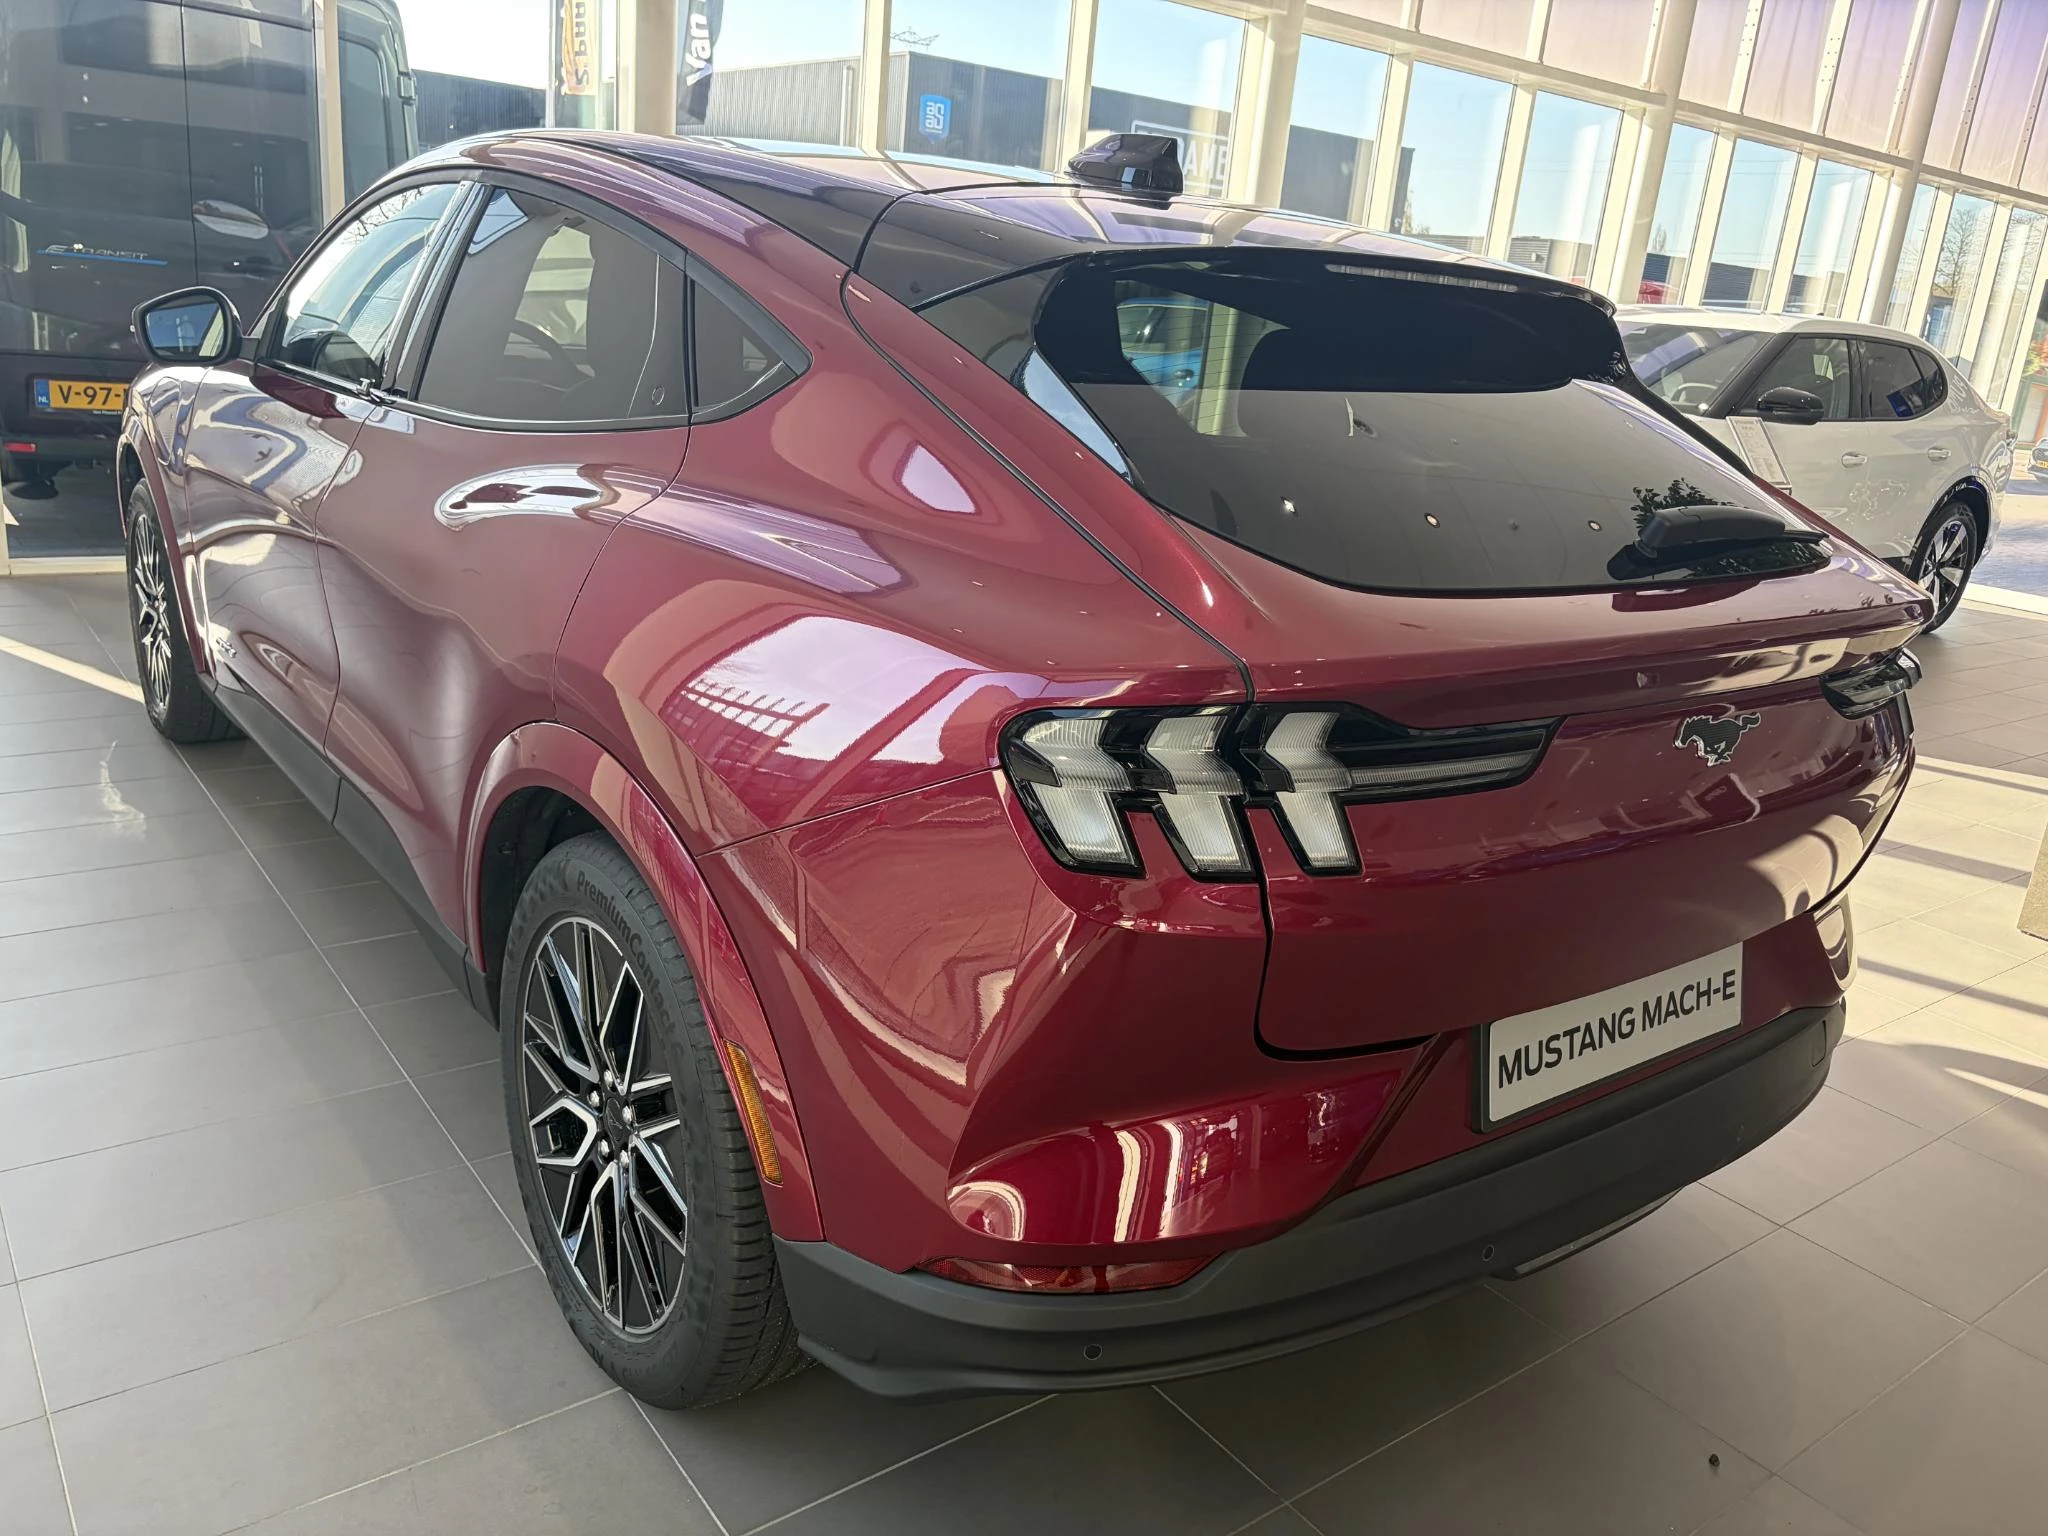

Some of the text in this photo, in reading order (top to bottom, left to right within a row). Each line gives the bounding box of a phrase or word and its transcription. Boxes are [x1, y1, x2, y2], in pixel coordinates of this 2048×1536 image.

[685, 13, 711, 86] Van
[38, 396, 49, 404] NL
[58, 384, 127, 406] V-97-
[1498, 969, 1736, 1088] MUSTANG MACH-E
